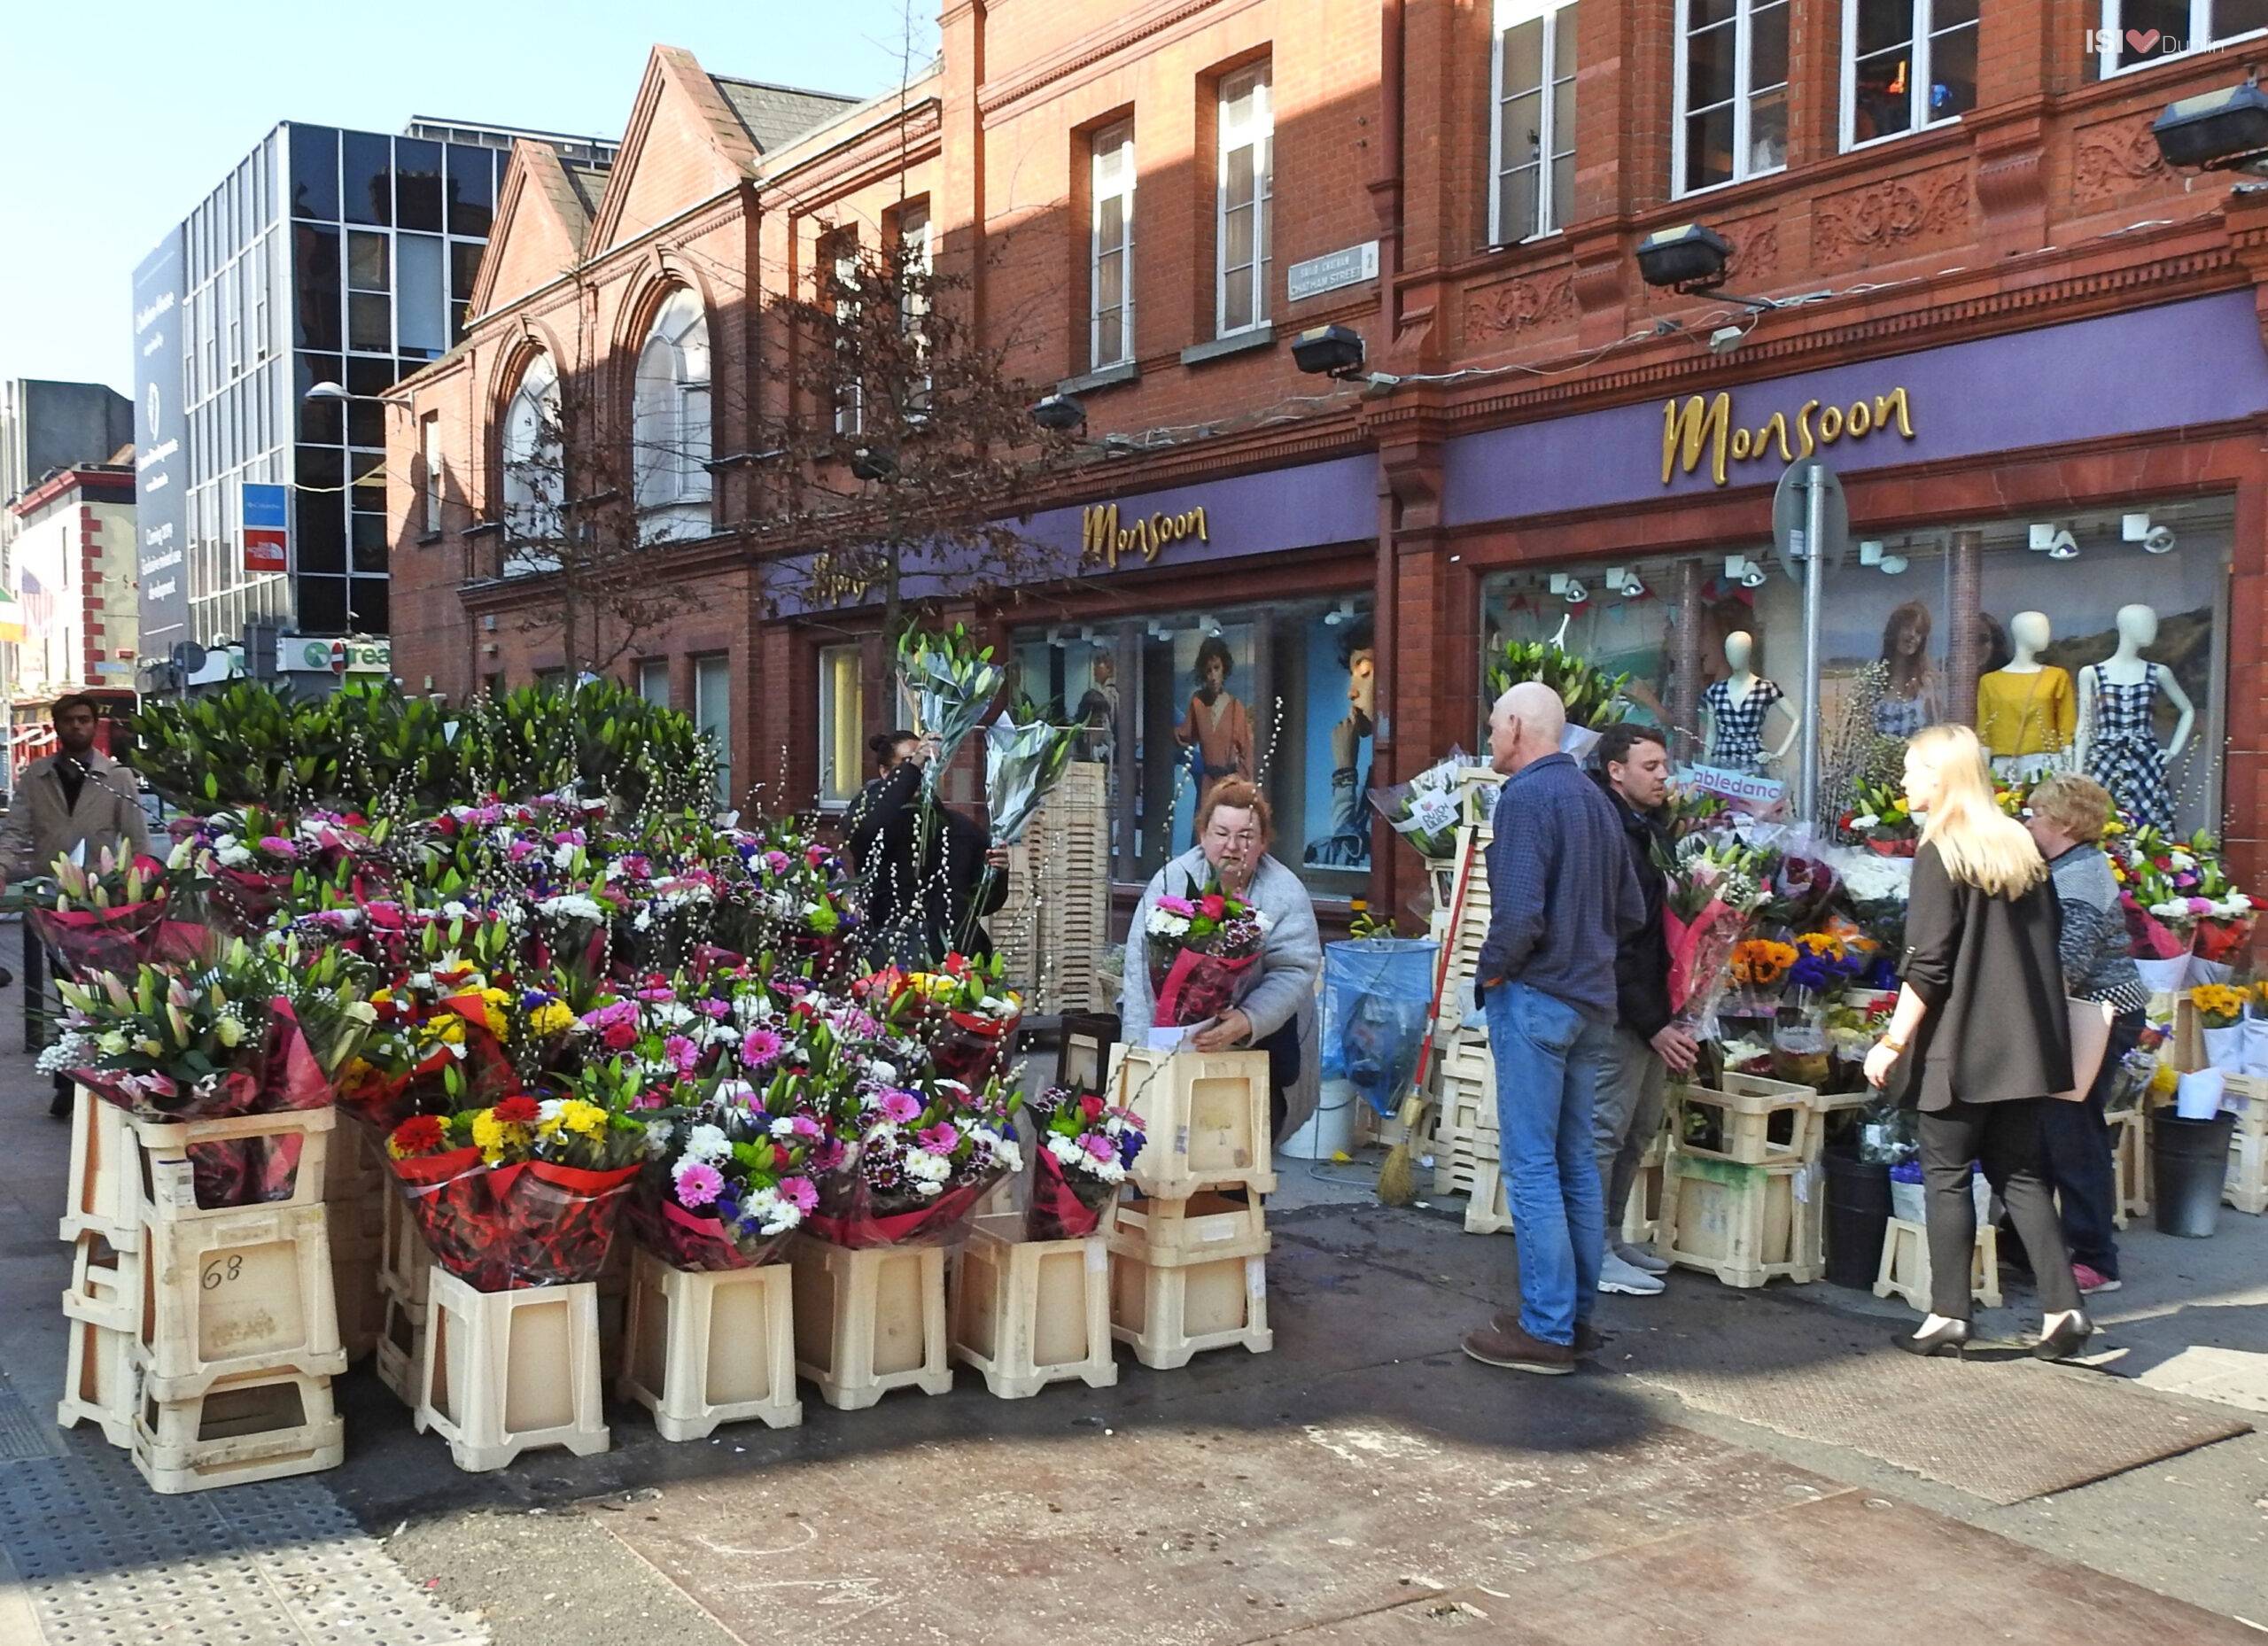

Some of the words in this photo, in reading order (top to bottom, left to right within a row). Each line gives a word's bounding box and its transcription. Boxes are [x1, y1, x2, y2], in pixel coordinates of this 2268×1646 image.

[1330, 267, 1363, 284] STREET
[1367, 253, 1373, 268] 2
[1661, 392, 1915, 485] Monsoon
[1083, 503, 1208, 569] Monsoon
[201, 1254, 243, 1291] 68
